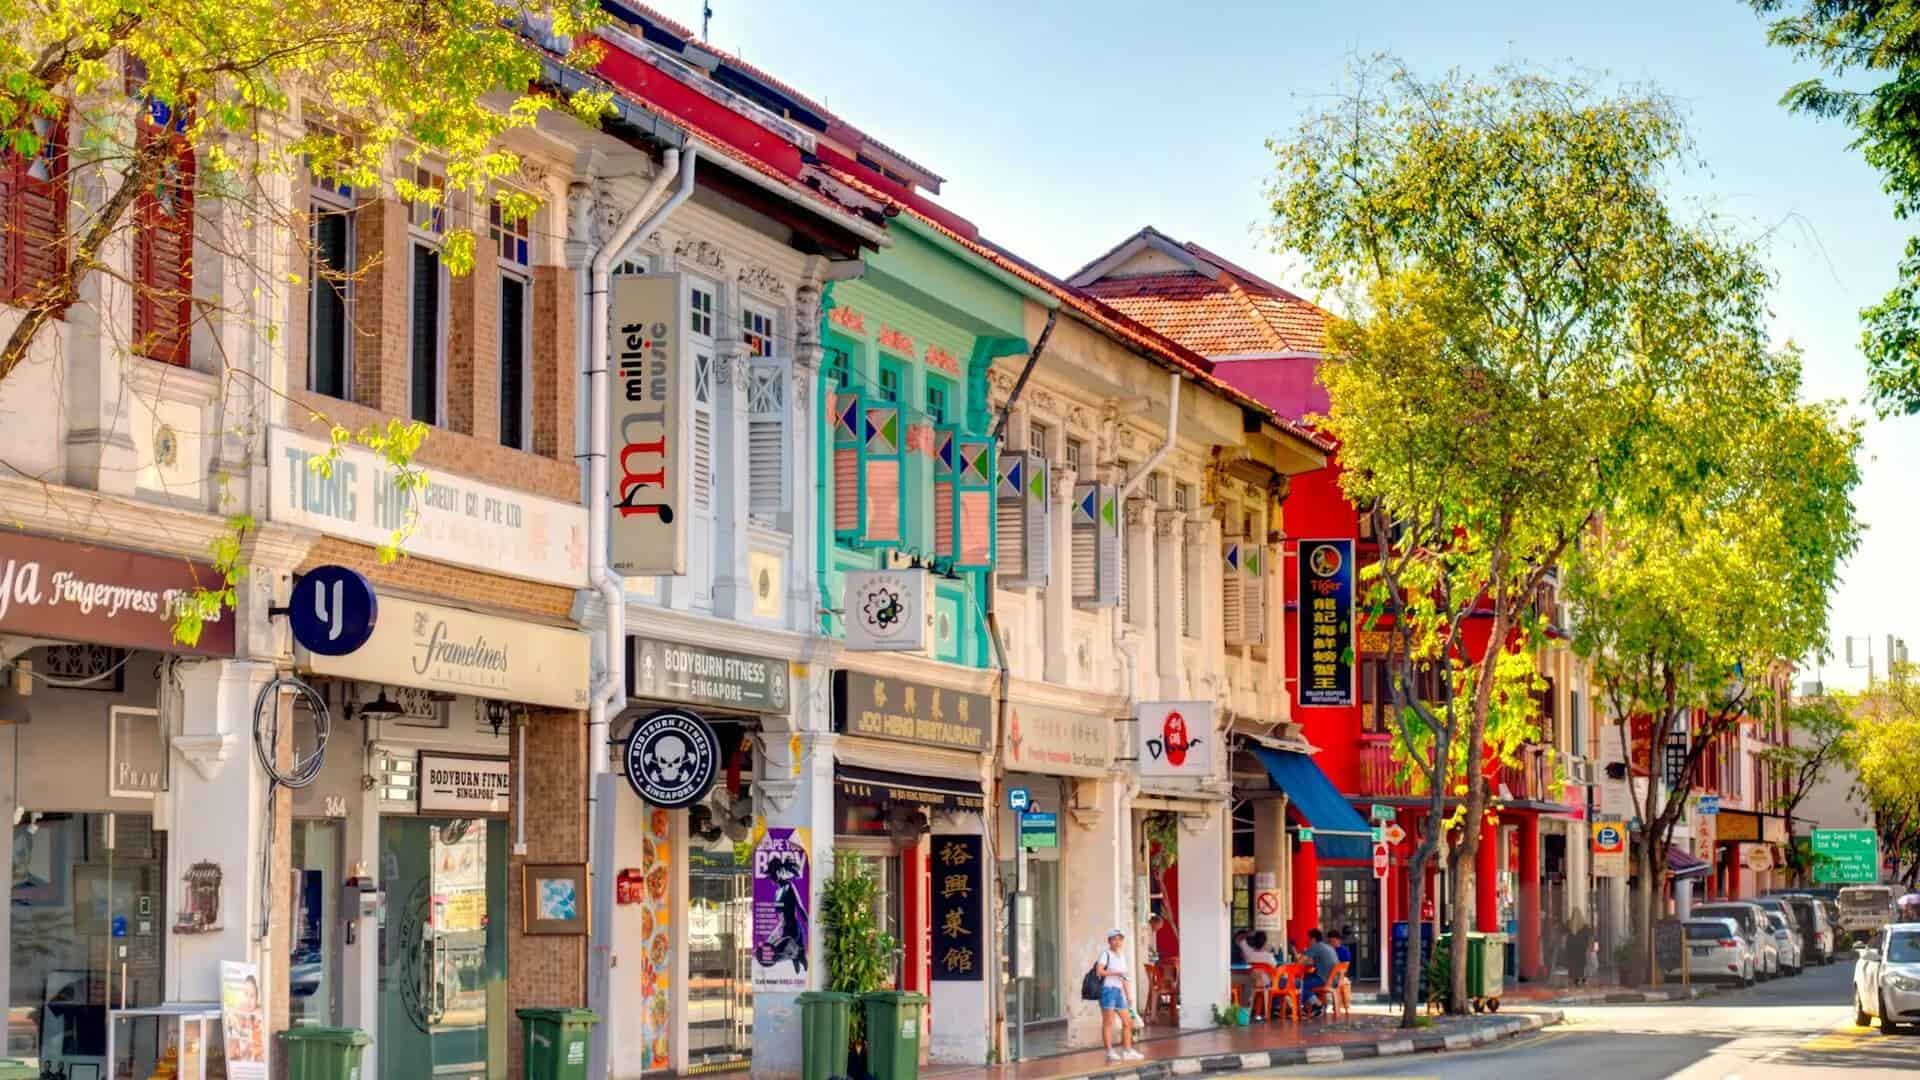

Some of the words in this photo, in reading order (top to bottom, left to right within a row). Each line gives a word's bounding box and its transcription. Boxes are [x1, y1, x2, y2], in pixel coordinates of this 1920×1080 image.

[619, 322, 642, 401] millet
[644, 321, 667, 401] music
[49, 570, 158, 618] Fingerpress
[1310, 579, 1343, 596] Tiger
[664, 648, 723, 679] BODYBURN
[724, 658, 766, 684] FITNESS
[690, 679, 743, 701] SINGAPORE
[632, 719, 677, 757] BODYBURN
[678, 719, 709, 757] FITNESS
[430, 769, 480, 787] BODYBURN
[482, 772, 509, 788] FITNE
[644, 783, 696, 800] SINGAPORE
[456, 787, 495, 800] SINGAPORE
